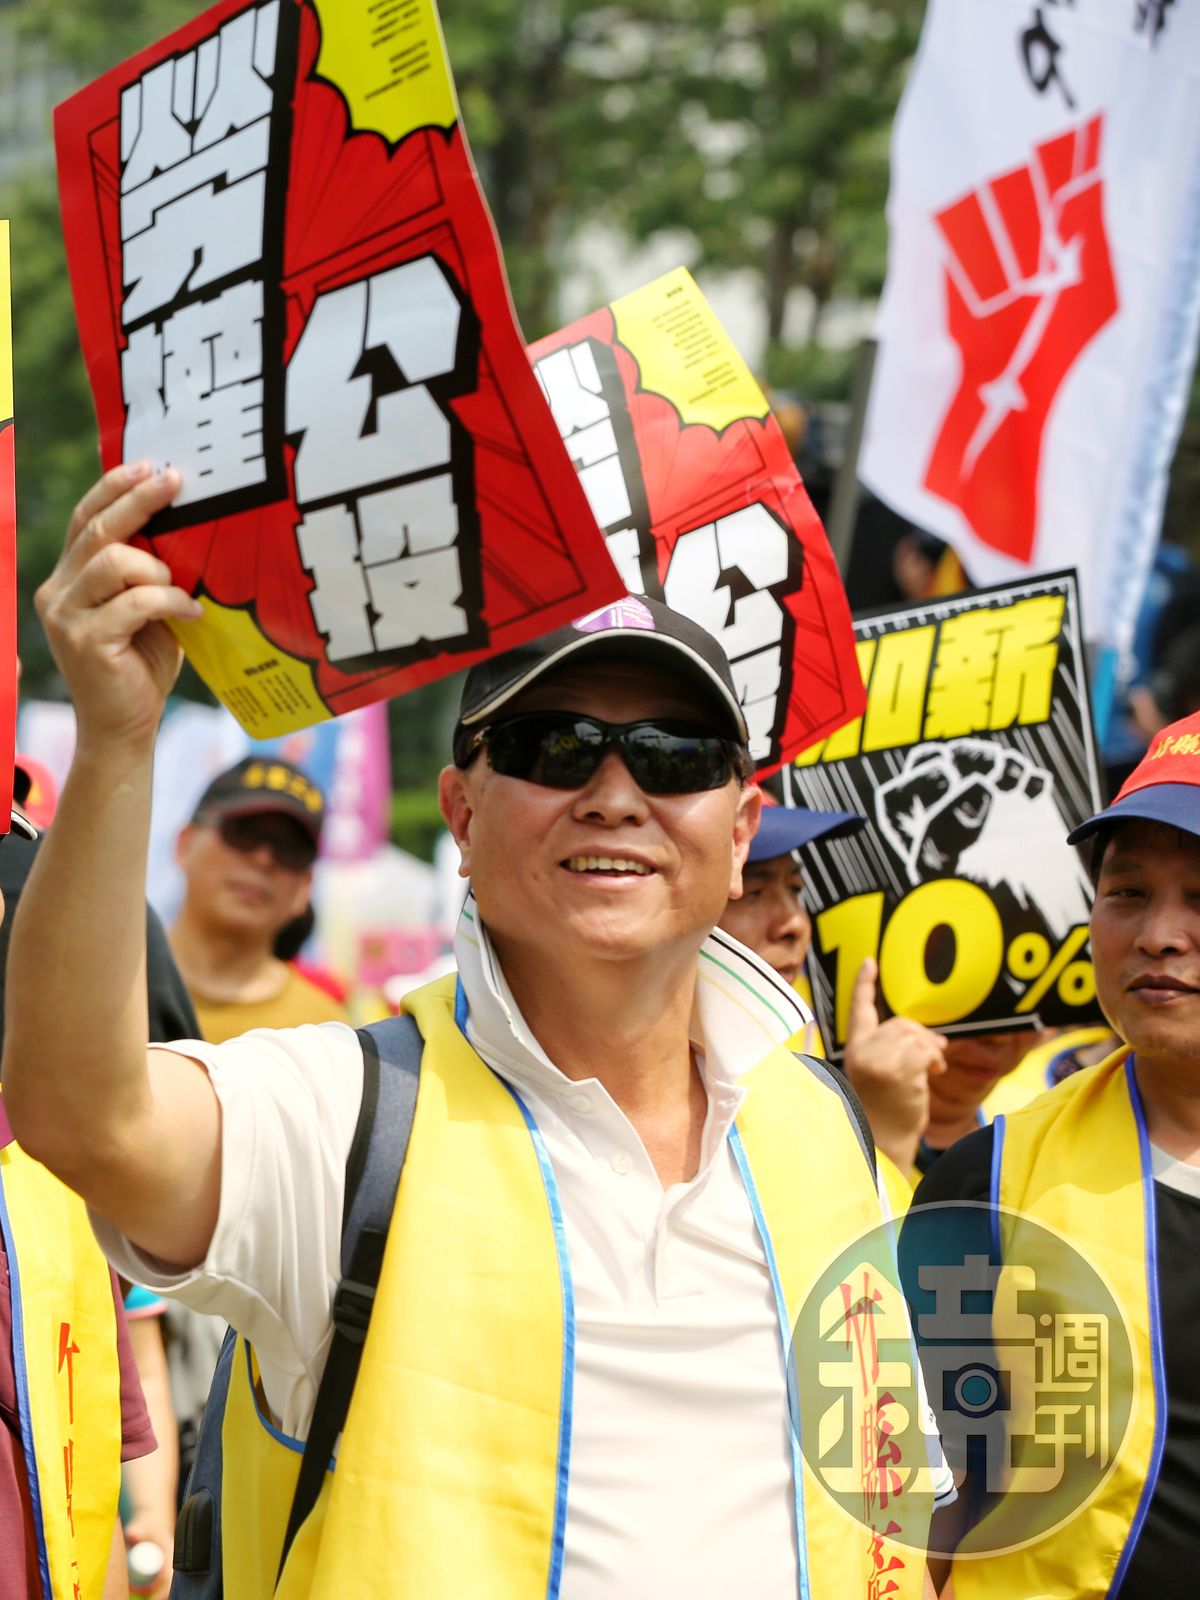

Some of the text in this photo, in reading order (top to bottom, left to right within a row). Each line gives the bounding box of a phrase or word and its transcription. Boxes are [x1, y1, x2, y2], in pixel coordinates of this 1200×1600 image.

[285, 254, 470, 662] 公投
[795, 595, 1067, 768] 加薪
[817, 878, 1098, 1045] 10%
